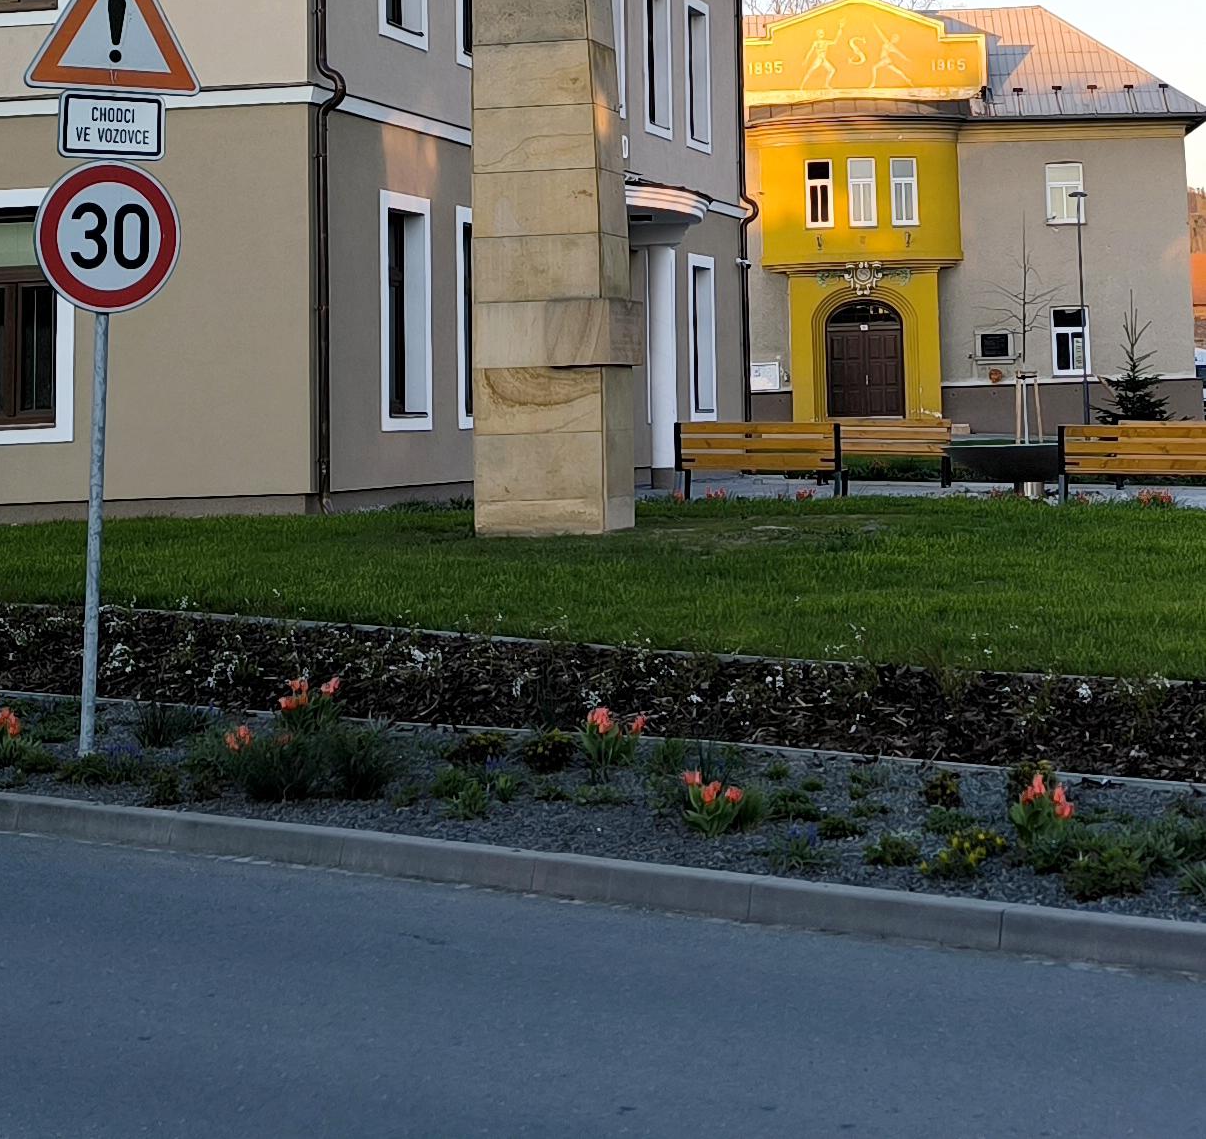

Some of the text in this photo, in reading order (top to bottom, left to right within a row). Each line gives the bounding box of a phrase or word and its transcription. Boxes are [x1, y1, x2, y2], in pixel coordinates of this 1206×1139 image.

[847, 36, 867, 65] S
[748, 61, 783, 75] 1895
[91, 106, 135, 124] CHODCI
[75, 126, 150, 145] VE VOZOVCE
[70, 202, 150, 270] 30
